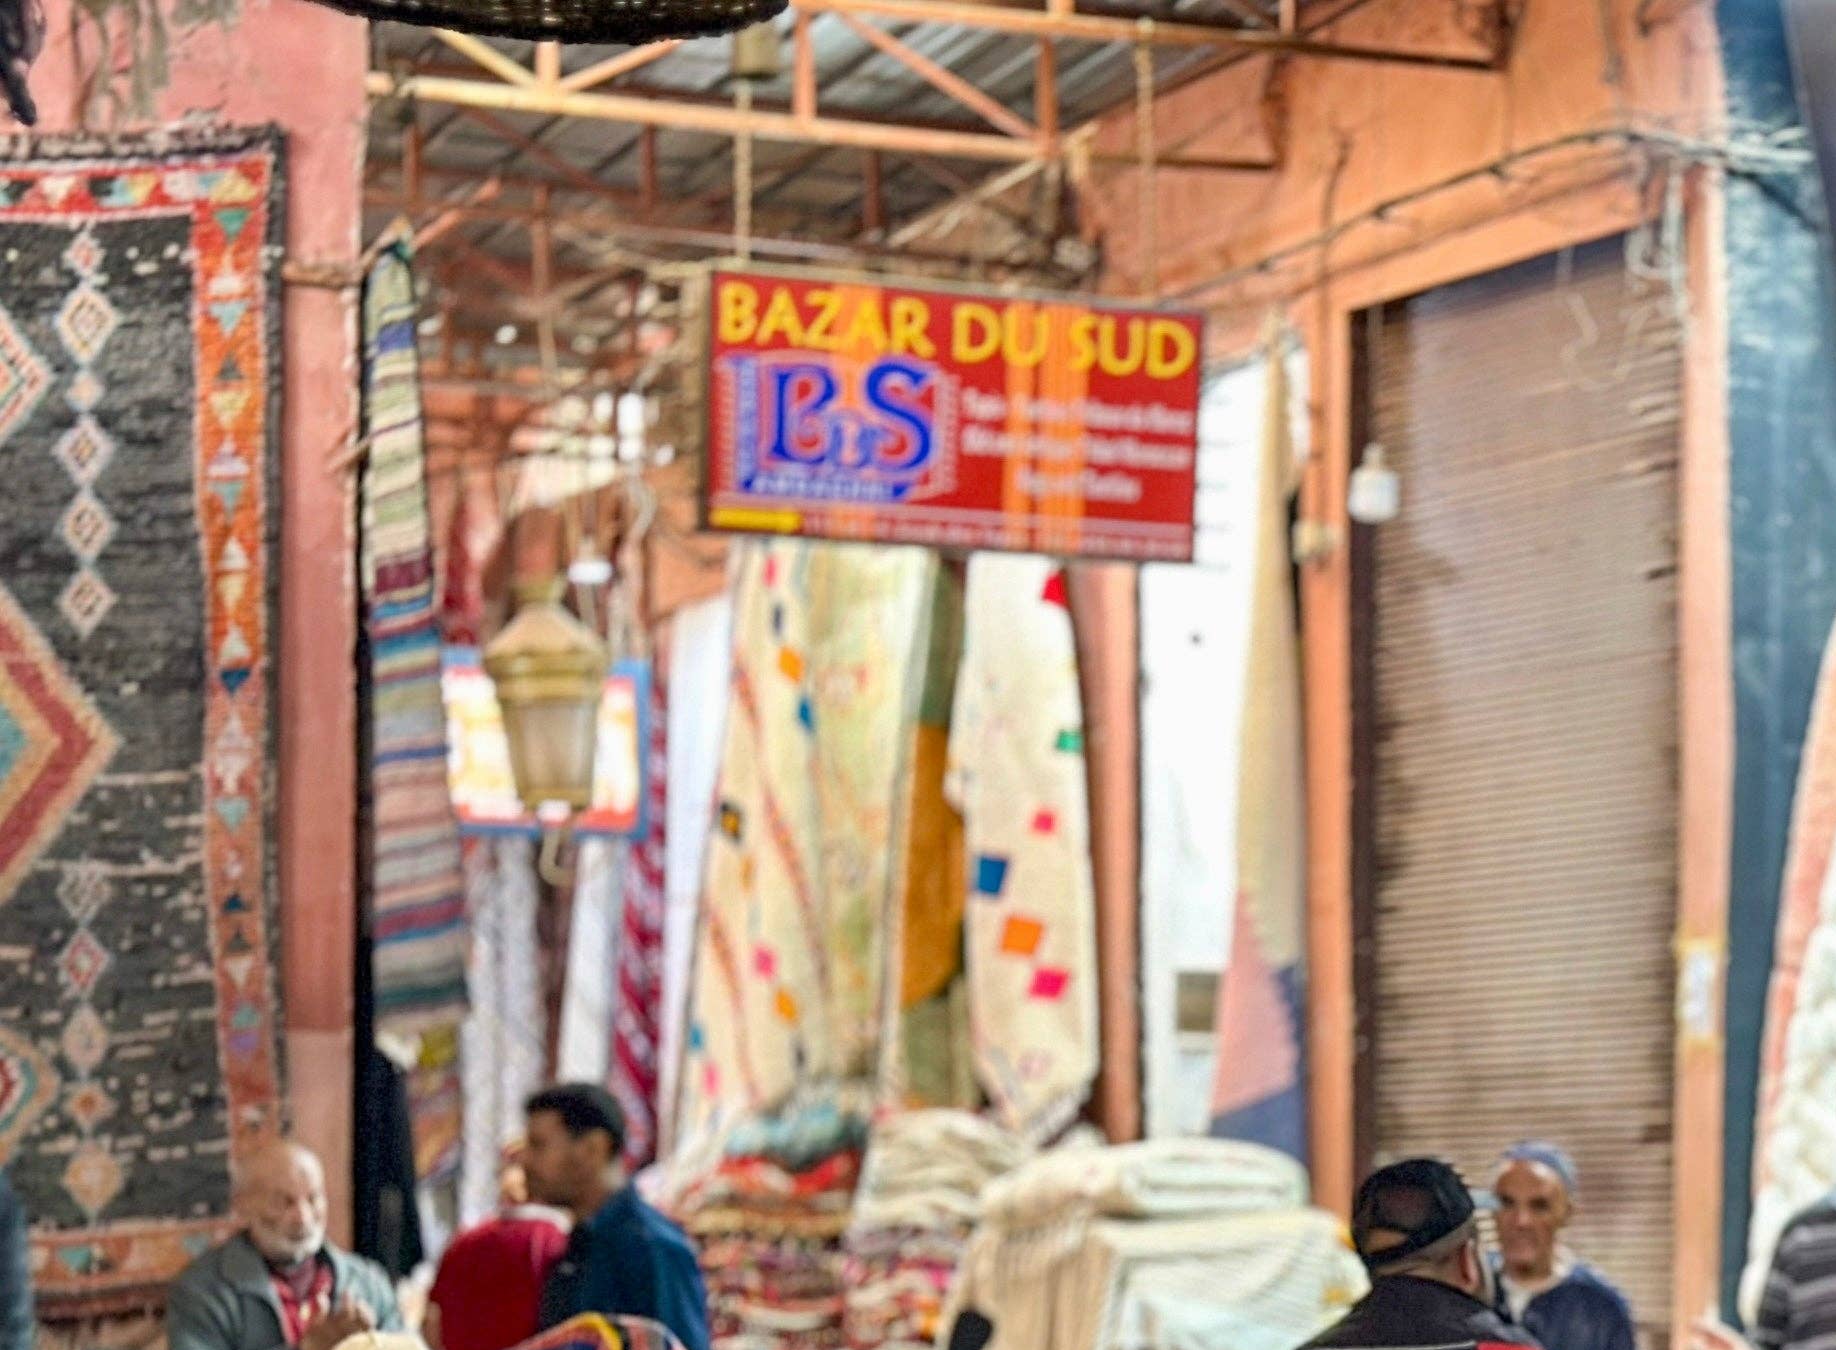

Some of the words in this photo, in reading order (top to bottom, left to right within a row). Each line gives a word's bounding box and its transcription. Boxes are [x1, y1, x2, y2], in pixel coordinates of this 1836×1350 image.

[718, 281, 935, 358] BAZAR
[951, 303, 1049, 366] DU
[1069, 314, 1195, 380] SUD
